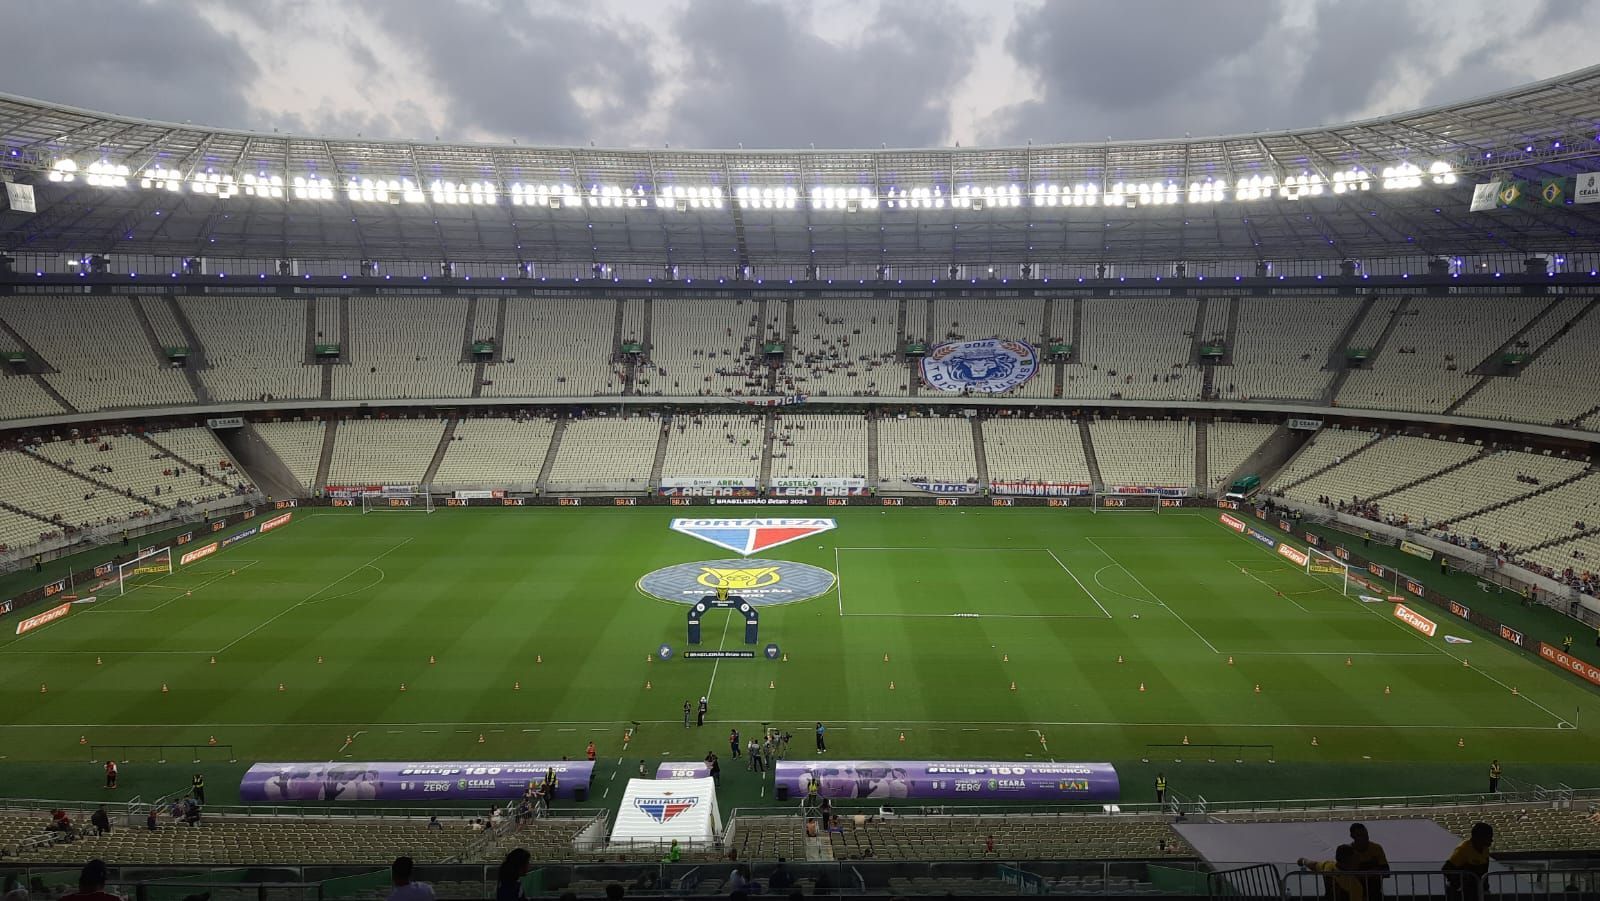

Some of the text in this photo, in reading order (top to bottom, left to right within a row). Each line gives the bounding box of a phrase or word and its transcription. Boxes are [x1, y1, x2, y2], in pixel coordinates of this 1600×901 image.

[682, 487, 733, 496] ARENA
[820, 487, 848, 496] 1918
[1045, 485, 1080, 496] FORTALEZA
[276, 500, 295, 509] BRAX
[1219, 501, 1237, 510] BRAX
[95, 563, 112, 577] BRAX
[46, 582, 64, 597] BRAX
[1407, 582, 1422, 596] BRAX
[1451, 603, 1468, 619] BRAX
[1397, 606, 1430, 632] Betano
[1502, 627, 1520, 646] BRAX
[1543, 647, 1555, 658] GOL
[1557, 654, 1570, 666] GOL
[1572, 661, 1585, 674] GOL
[465, 767, 500, 775] 180
[989, 767, 1025, 775] 180
[468, 778, 495, 786] CEARÁ
[998, 778, 1025, 786] CEARÁ
